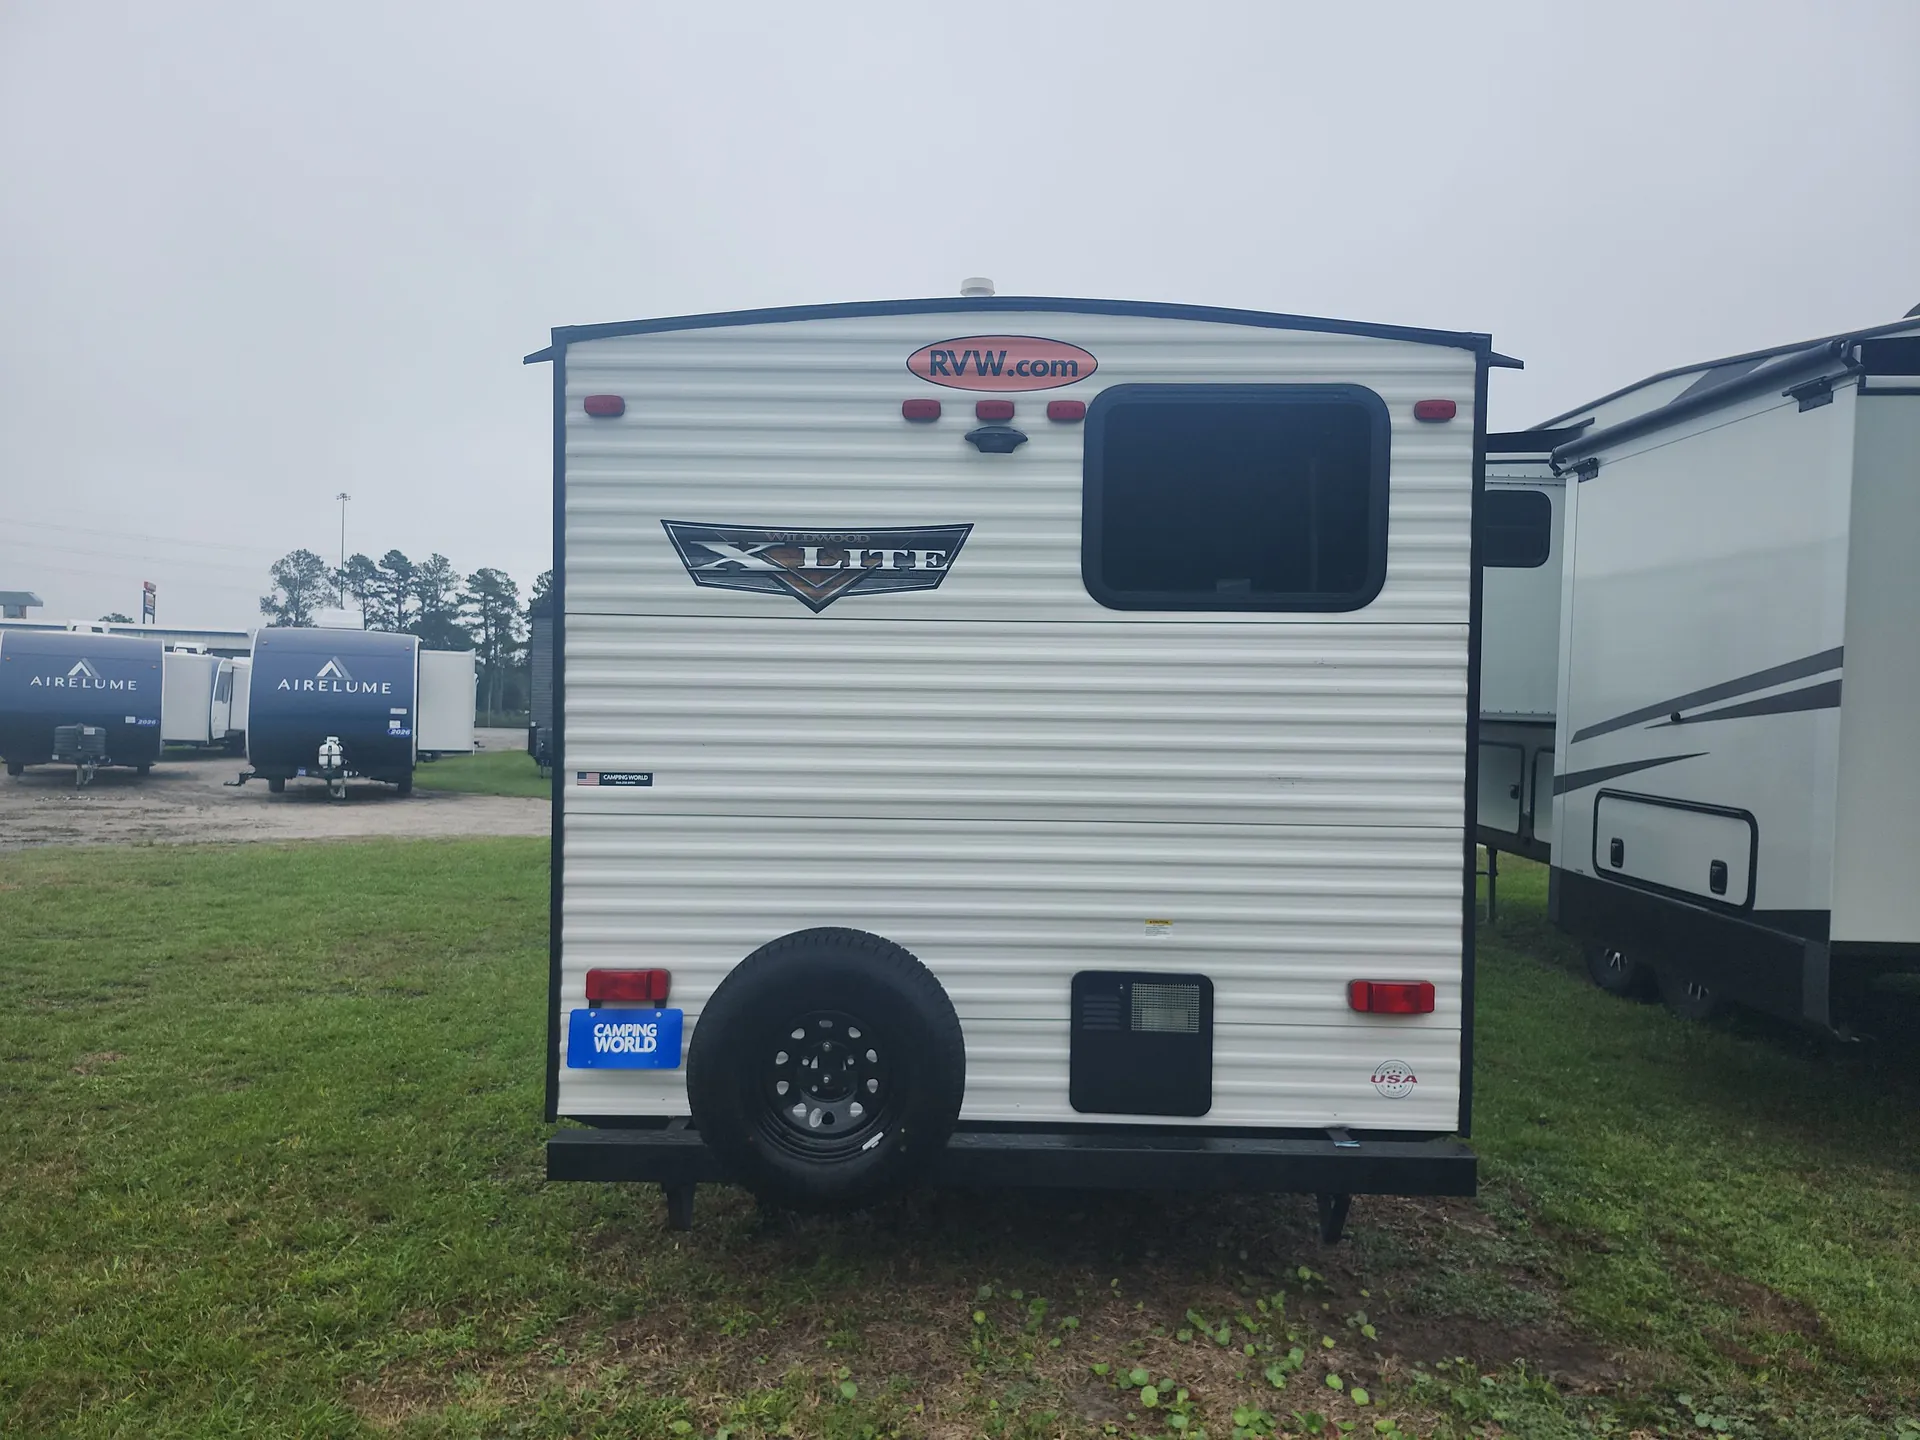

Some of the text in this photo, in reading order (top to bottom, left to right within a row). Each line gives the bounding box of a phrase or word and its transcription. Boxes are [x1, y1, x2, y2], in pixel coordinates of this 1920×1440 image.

[930, 350, 1078, 377] RVW.com
[764, 532, 871, 544] WILDWOOD
[688, 541, 950, 572] X LITE
[30, 675, 137, 691] AIRELUME
[277, 678, 392, 695] AIRELUME
[389, 728, 411, 736] 2026
[593, 1023, 658, 1037] CAMPING
[593, 1036, 658, 1053] WORLD
[1370, 1074, 1418, 1084] USA
